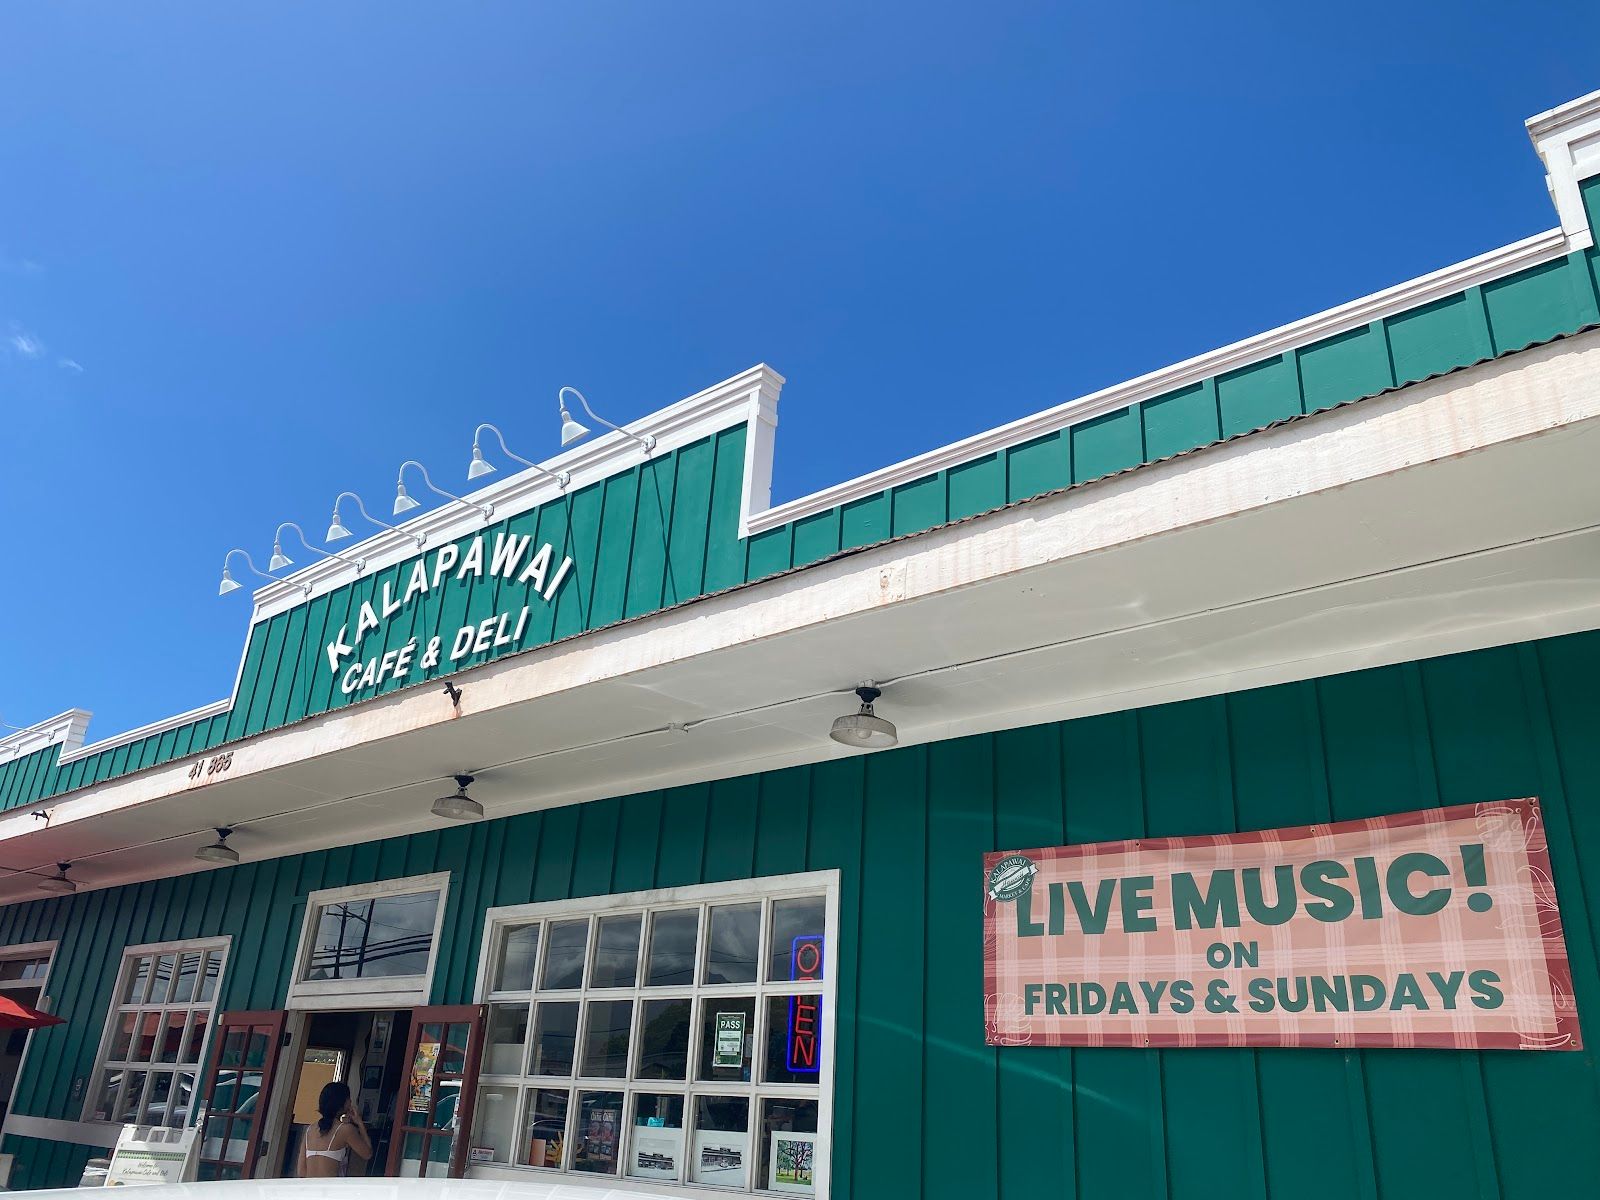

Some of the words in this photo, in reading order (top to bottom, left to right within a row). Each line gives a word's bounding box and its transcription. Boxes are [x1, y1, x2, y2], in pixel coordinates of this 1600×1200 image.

[327, 533, 573, 673] KALAPAWAI
[341, 636, 417, 694] CAFÉ
[420, 636, 441, 669] &
[450, 606, 530, 661] DELI
[188, 760, 205, 780] 41
[990, 858, 1026, 884] KALAPAWAI
[1016, 874, 1158, 938] LIVE
[1171, 843, 1492, 930] MUSIC!
[1206, 941, 1259, 969] ON
[1024, 979, 1196, 1016] FRIDAYS
[1204, 979, 1239, 1014] &
[1248, 969, 1504, 1013] SUNDAYS
[720, 1020, 741, 1029] PASS
